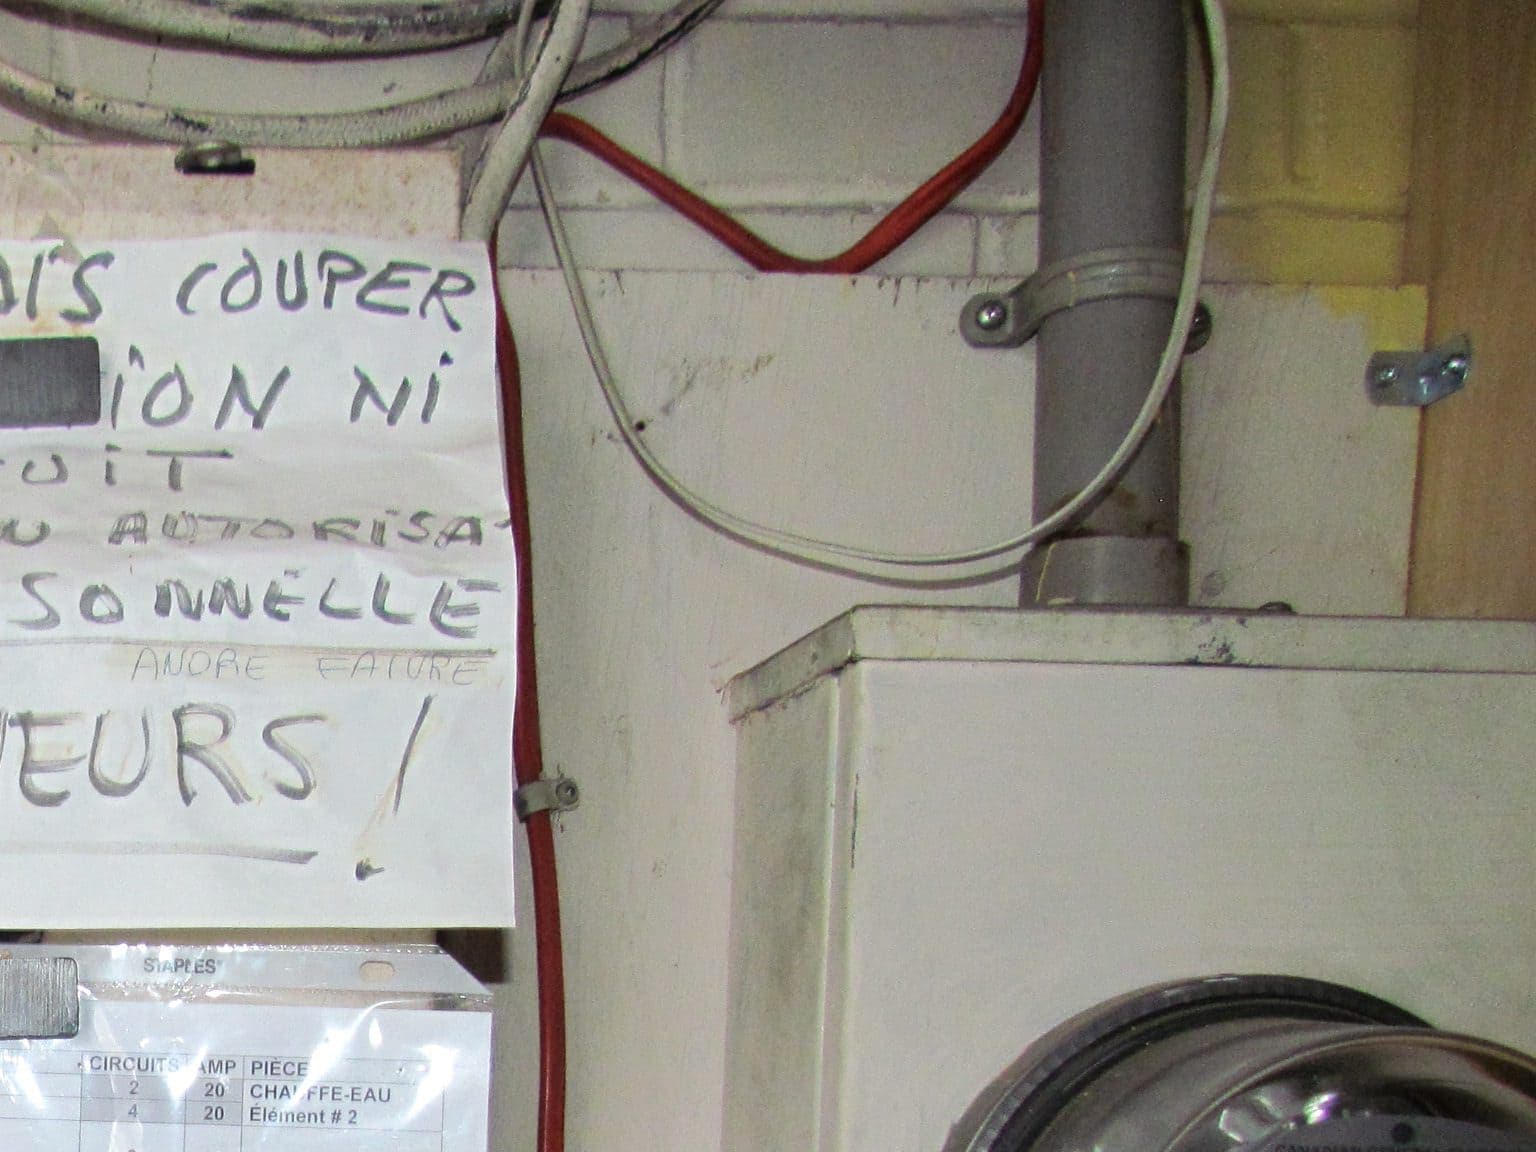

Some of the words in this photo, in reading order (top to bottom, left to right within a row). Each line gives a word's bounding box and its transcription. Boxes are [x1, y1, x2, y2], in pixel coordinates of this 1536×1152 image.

[176, 248, 476, 332] COUPER
[89, 1055, 180, 1073] CIRCUITS
[129, 1080, 139, 1095] 2
[204, 1082, 225, 1098] 20
[127, 1103, 138, 1118] 4
[204, 1106, 225, 1121] 20
[249, 1102, 325, 1124] Élément
[331, 1109, 342, 1124] #
[348, 1109, 358, 1125] 2
